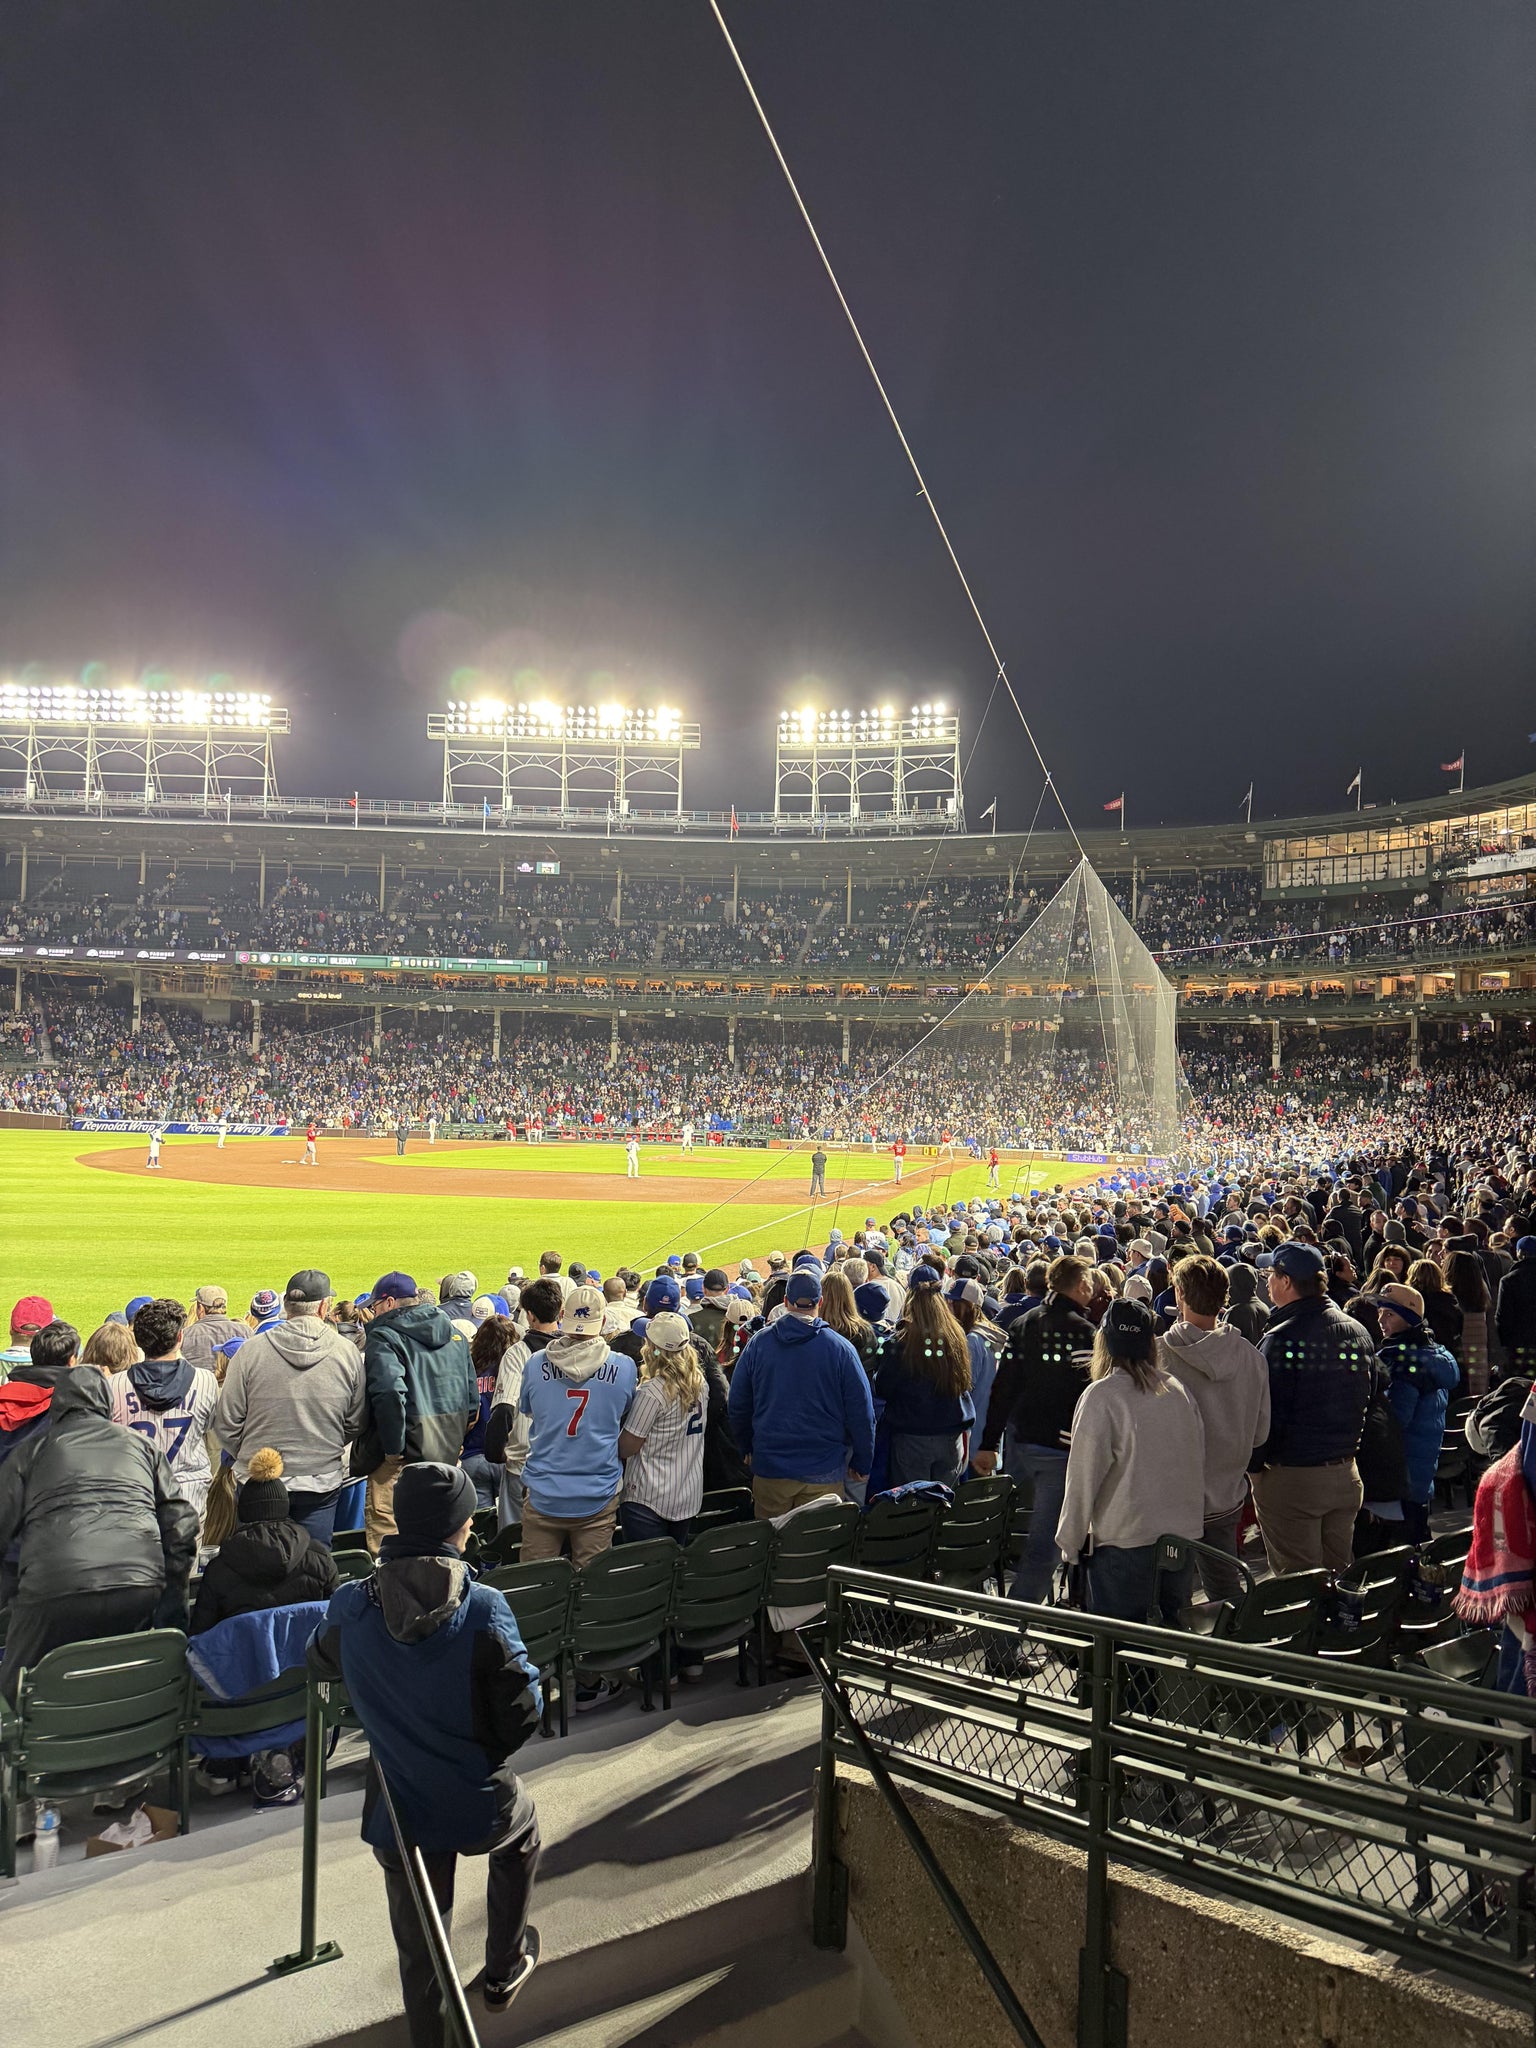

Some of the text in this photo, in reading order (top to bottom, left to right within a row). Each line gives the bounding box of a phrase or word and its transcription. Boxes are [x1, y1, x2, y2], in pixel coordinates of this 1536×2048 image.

[313, 991, 327, 999] suite
[328, 991, 342, 1000] level
[82, 1120, 157, 1133] Reynolds Wrap
[186, 1123, 262, 1135] Reynos Wrap
[1072, 1154, 1103, 1163] StubHub
[541, 1362, 619, 1385] SWON
[566, 1388, 591, 1437] 7
[1166, 1544, 1178, 1559] 104
